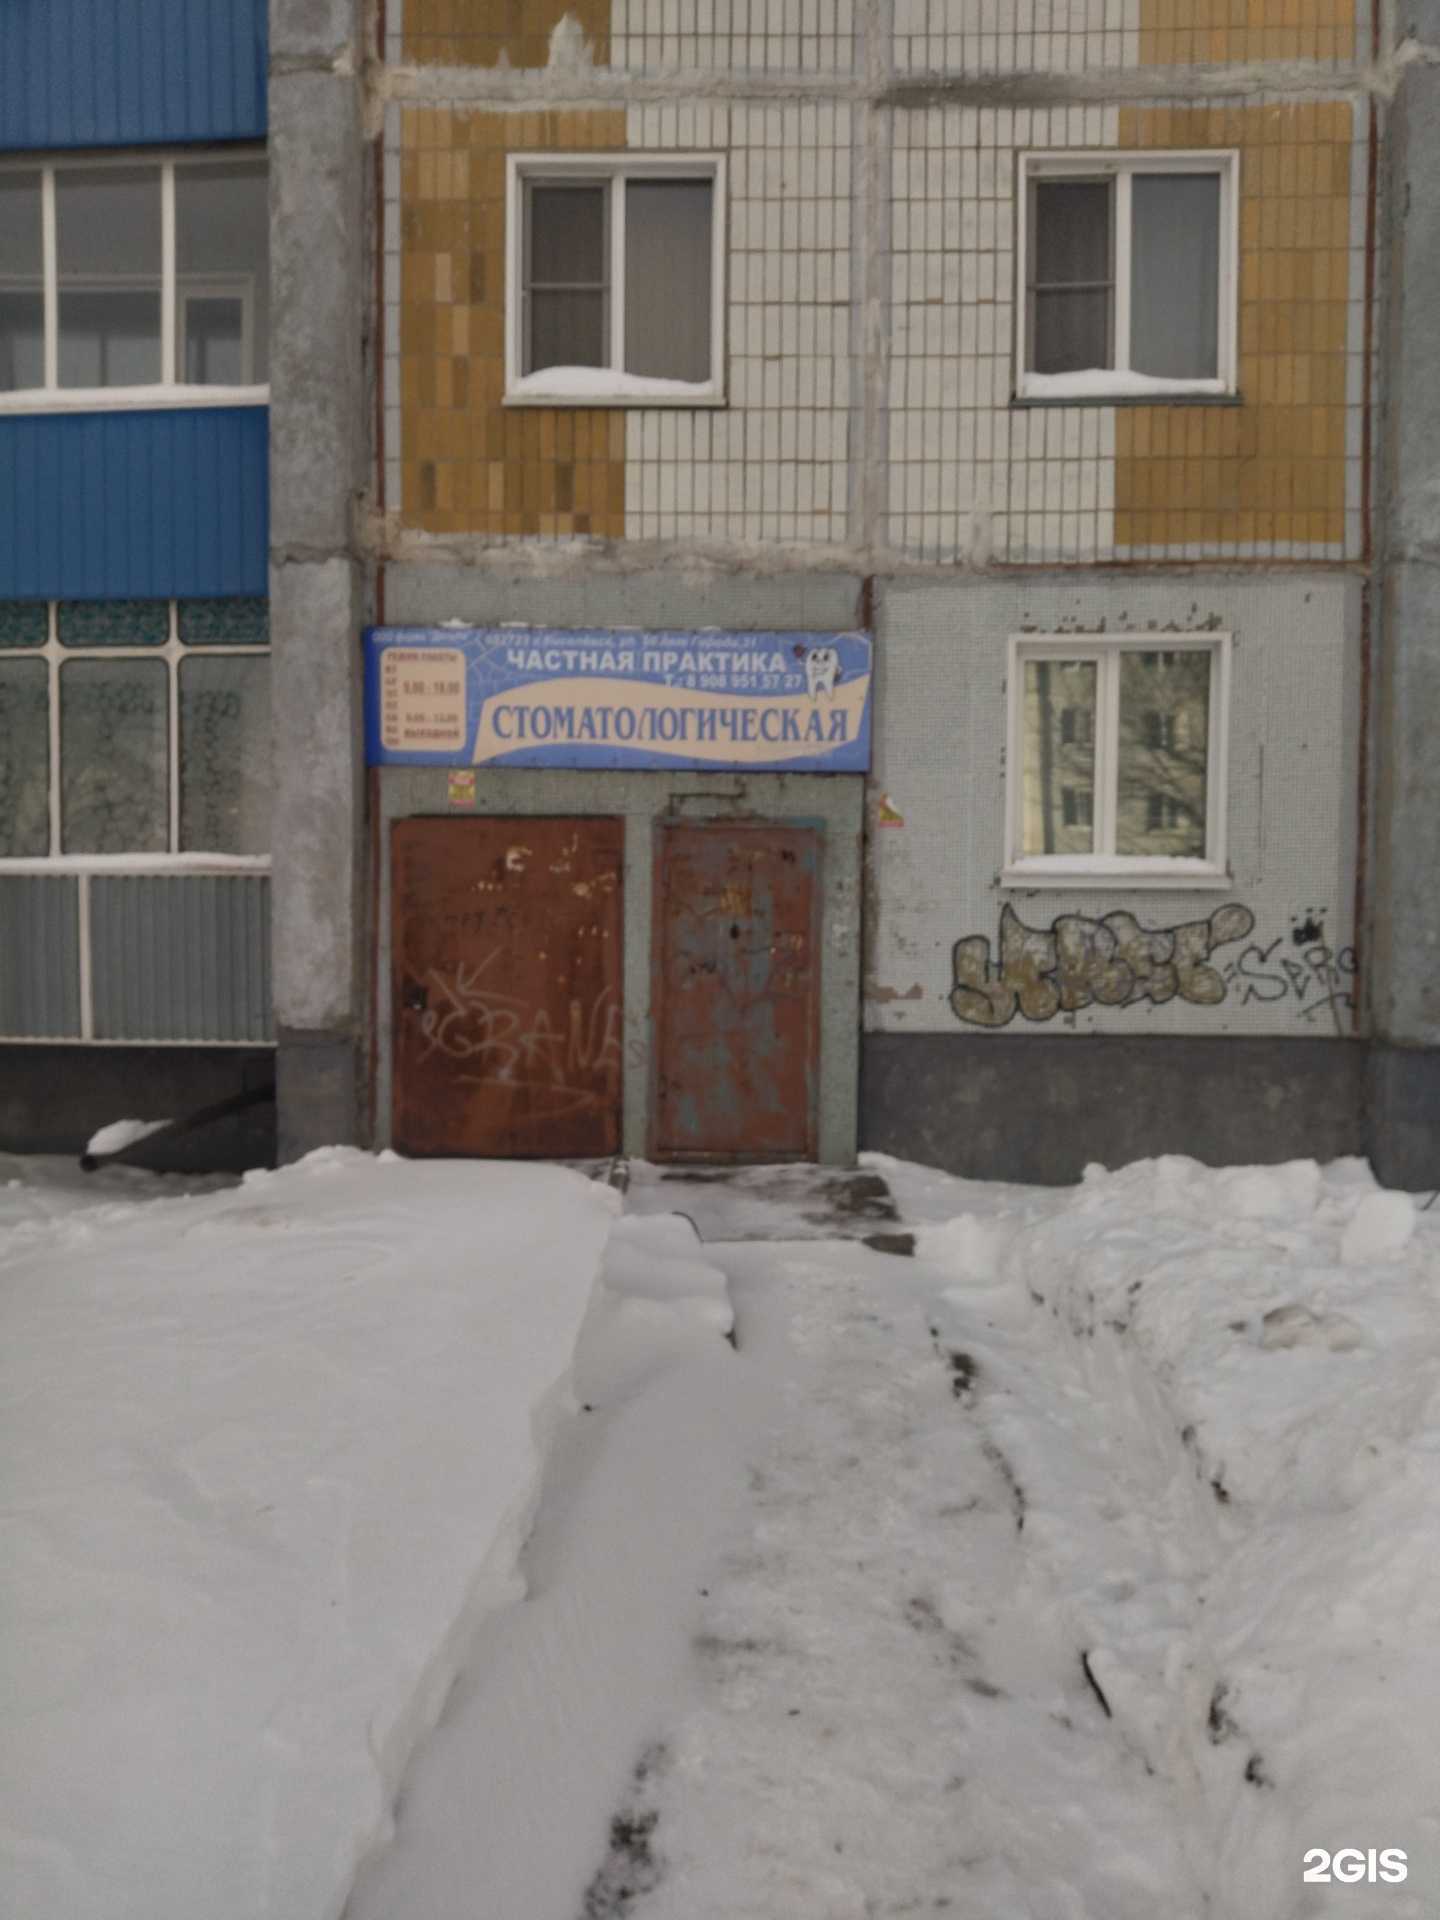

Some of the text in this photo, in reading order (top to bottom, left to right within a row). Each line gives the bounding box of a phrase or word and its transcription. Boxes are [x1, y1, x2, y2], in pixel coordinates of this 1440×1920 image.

[507, 650, 786, 673] ЧАСТНАЯ ПРАКТИКА
[492, 705, 848, 742] СТОМАТОЛОГИЧЕСКАЯ
